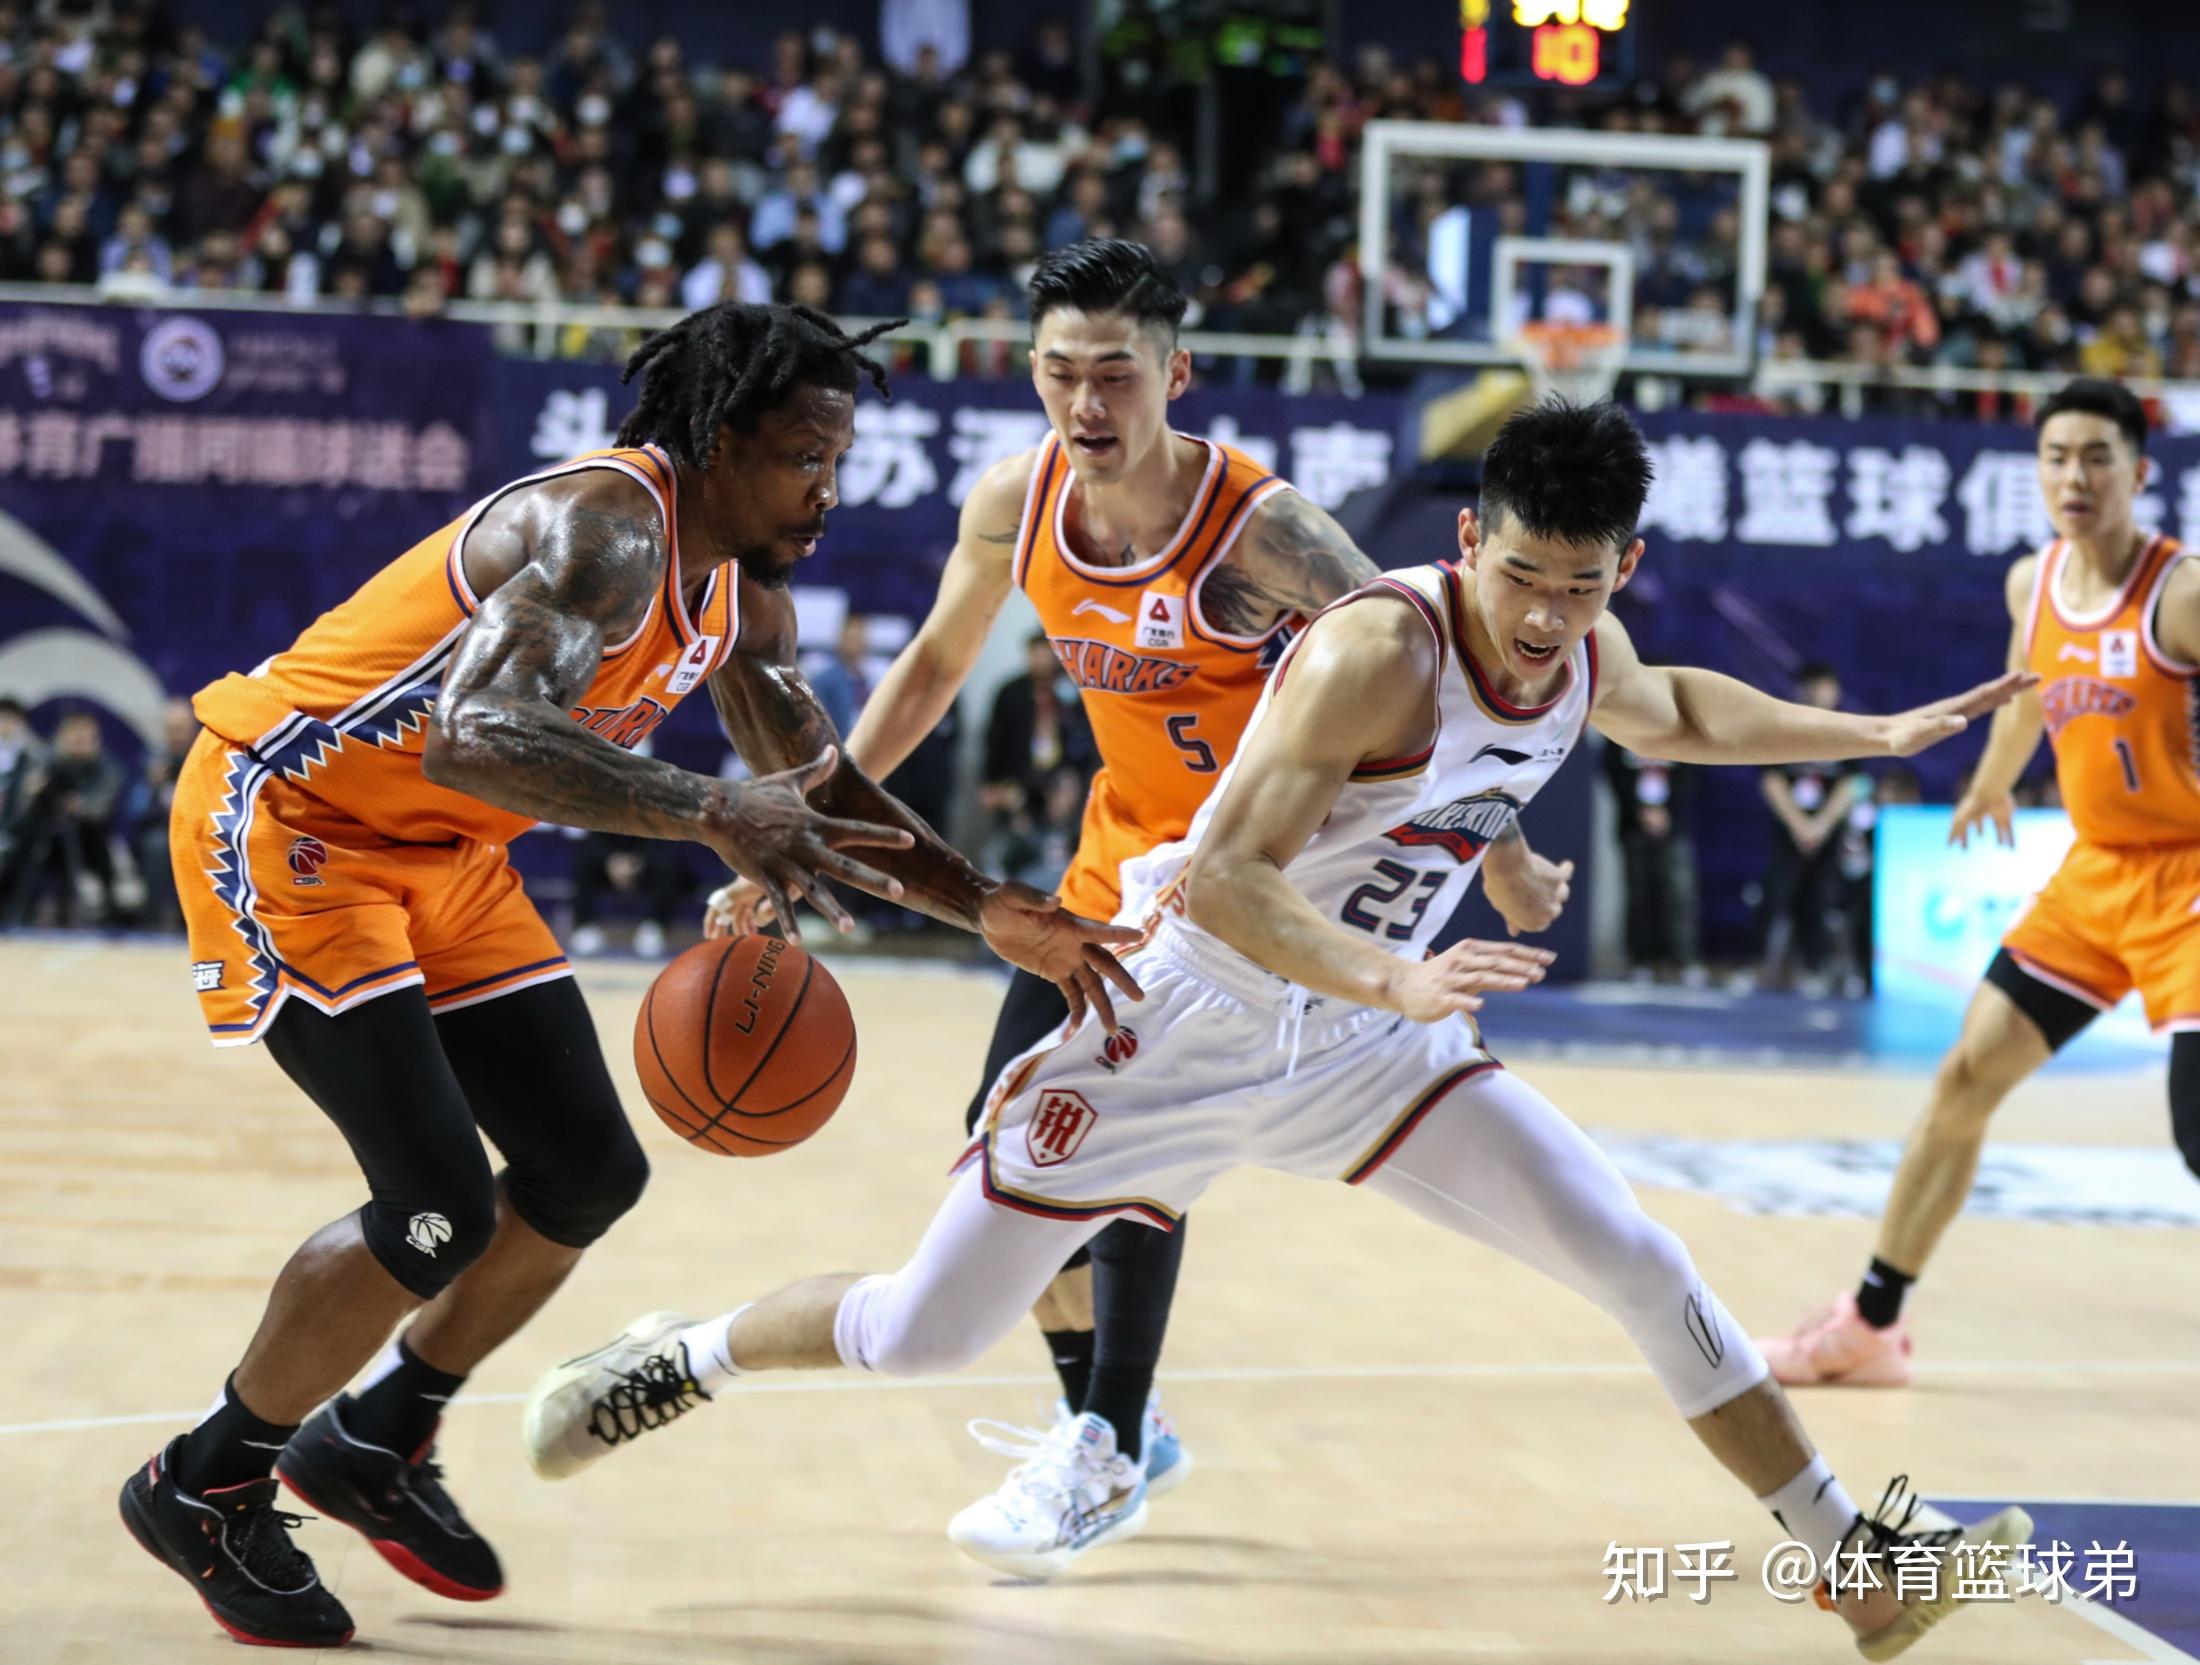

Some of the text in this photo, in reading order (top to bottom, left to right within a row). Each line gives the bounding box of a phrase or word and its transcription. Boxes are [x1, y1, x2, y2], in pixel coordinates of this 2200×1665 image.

[1532, 25, 1599, 85] 10
[1048, 637, 1199, 694] HARKS
[1165, 714, 1219, 775] 5
[2114, 738, 2143, 793] 1
[1340, 858, 1450, 942] 23
[734, 938, 787, 1034] LI-NING
